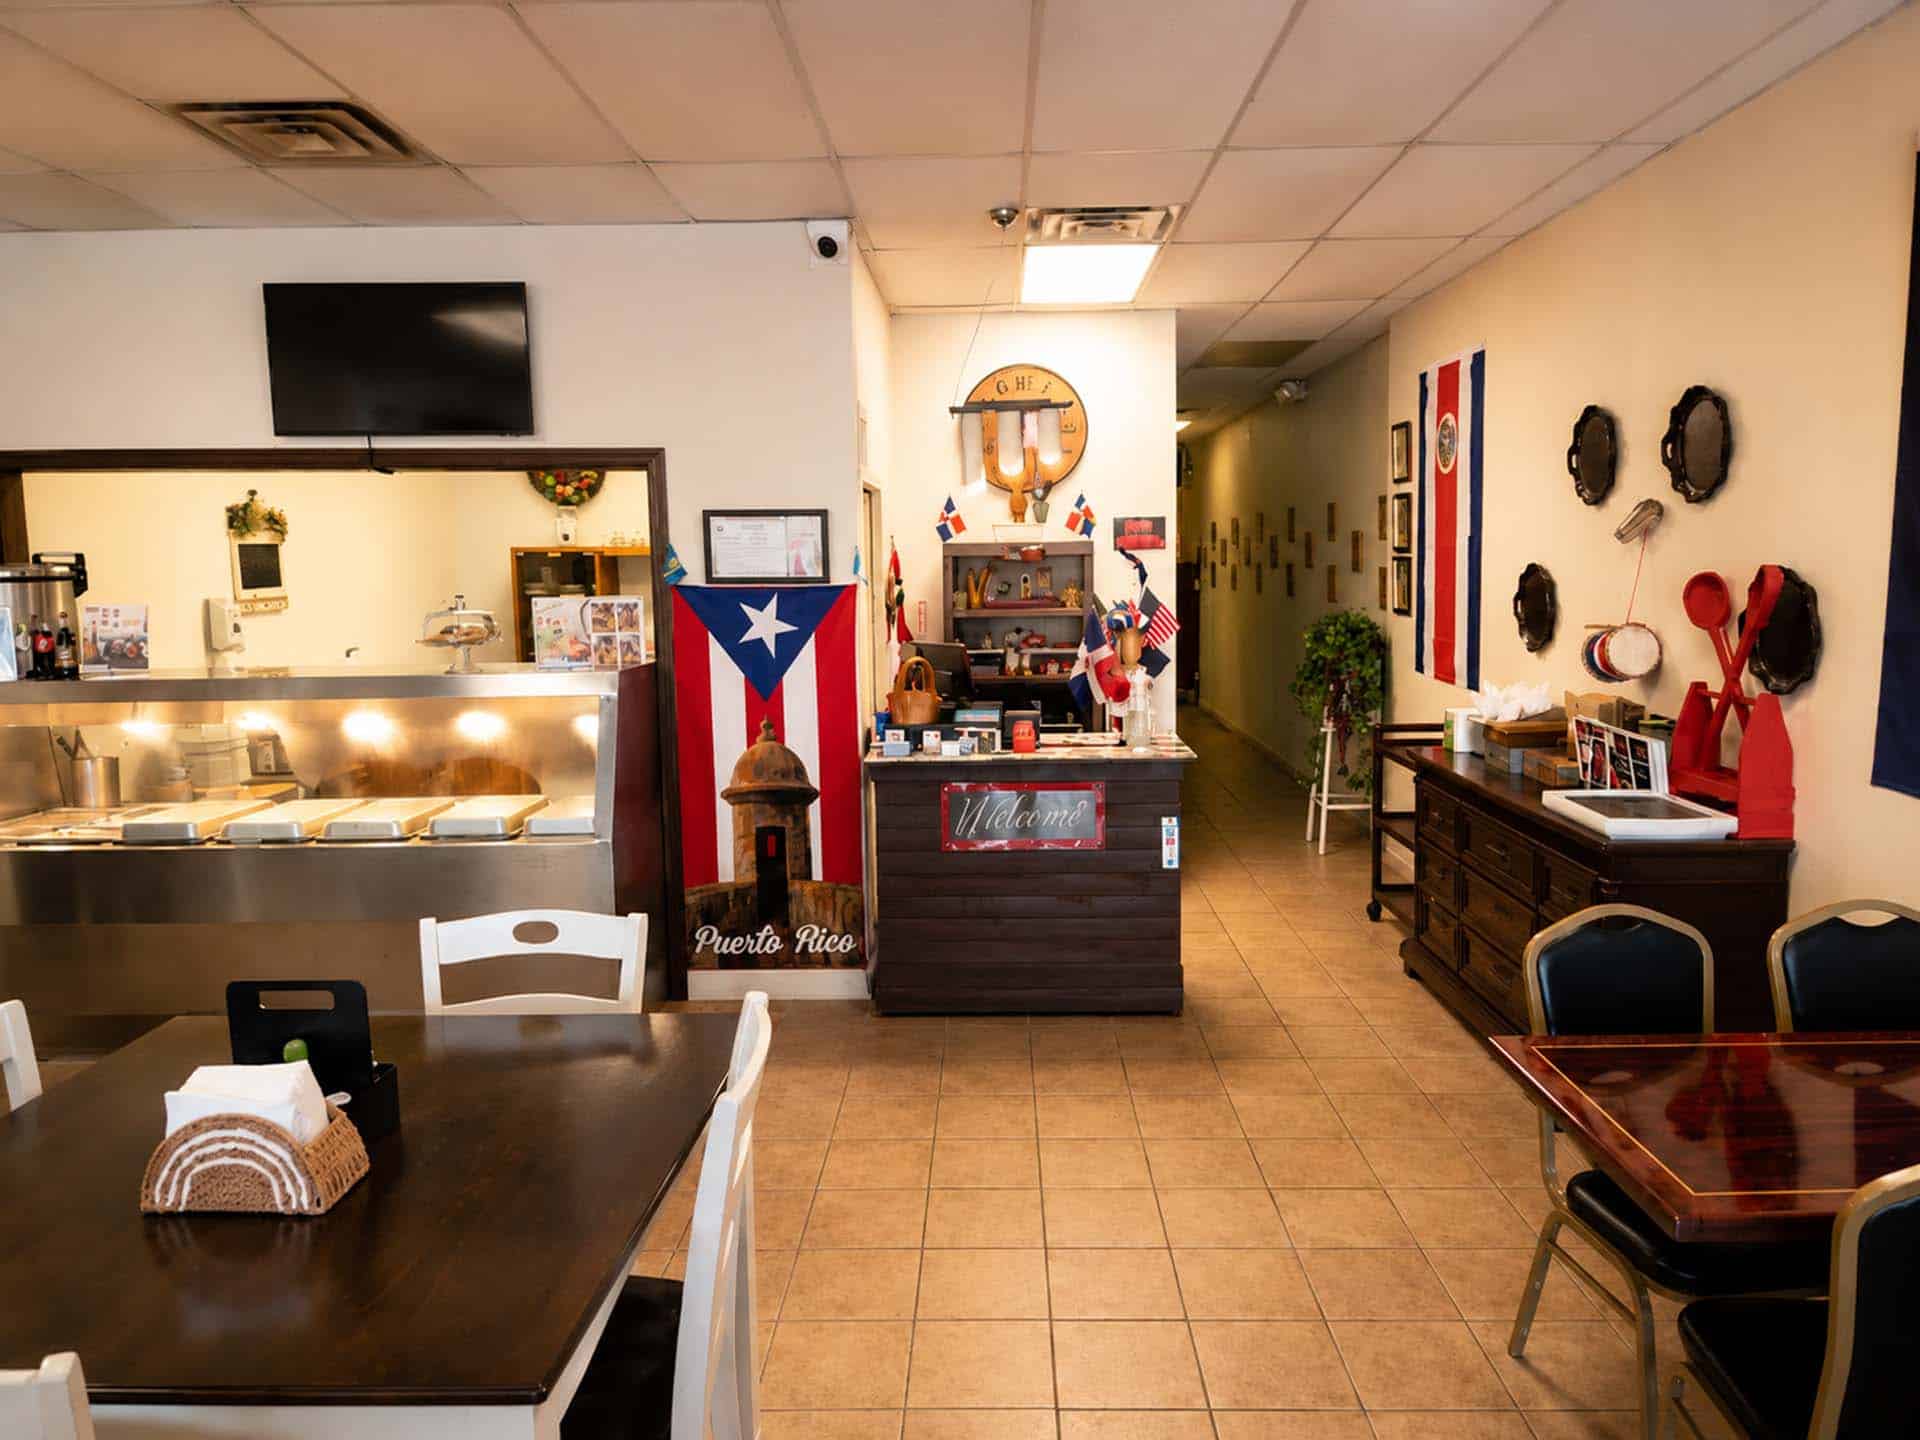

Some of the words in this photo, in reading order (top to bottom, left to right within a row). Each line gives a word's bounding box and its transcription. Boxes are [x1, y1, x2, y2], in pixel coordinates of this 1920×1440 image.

[955, 794, 1088, 838] Welcome
[694, 924, 783, 954] Puerto
[795, 924, 856, 954] Rico
